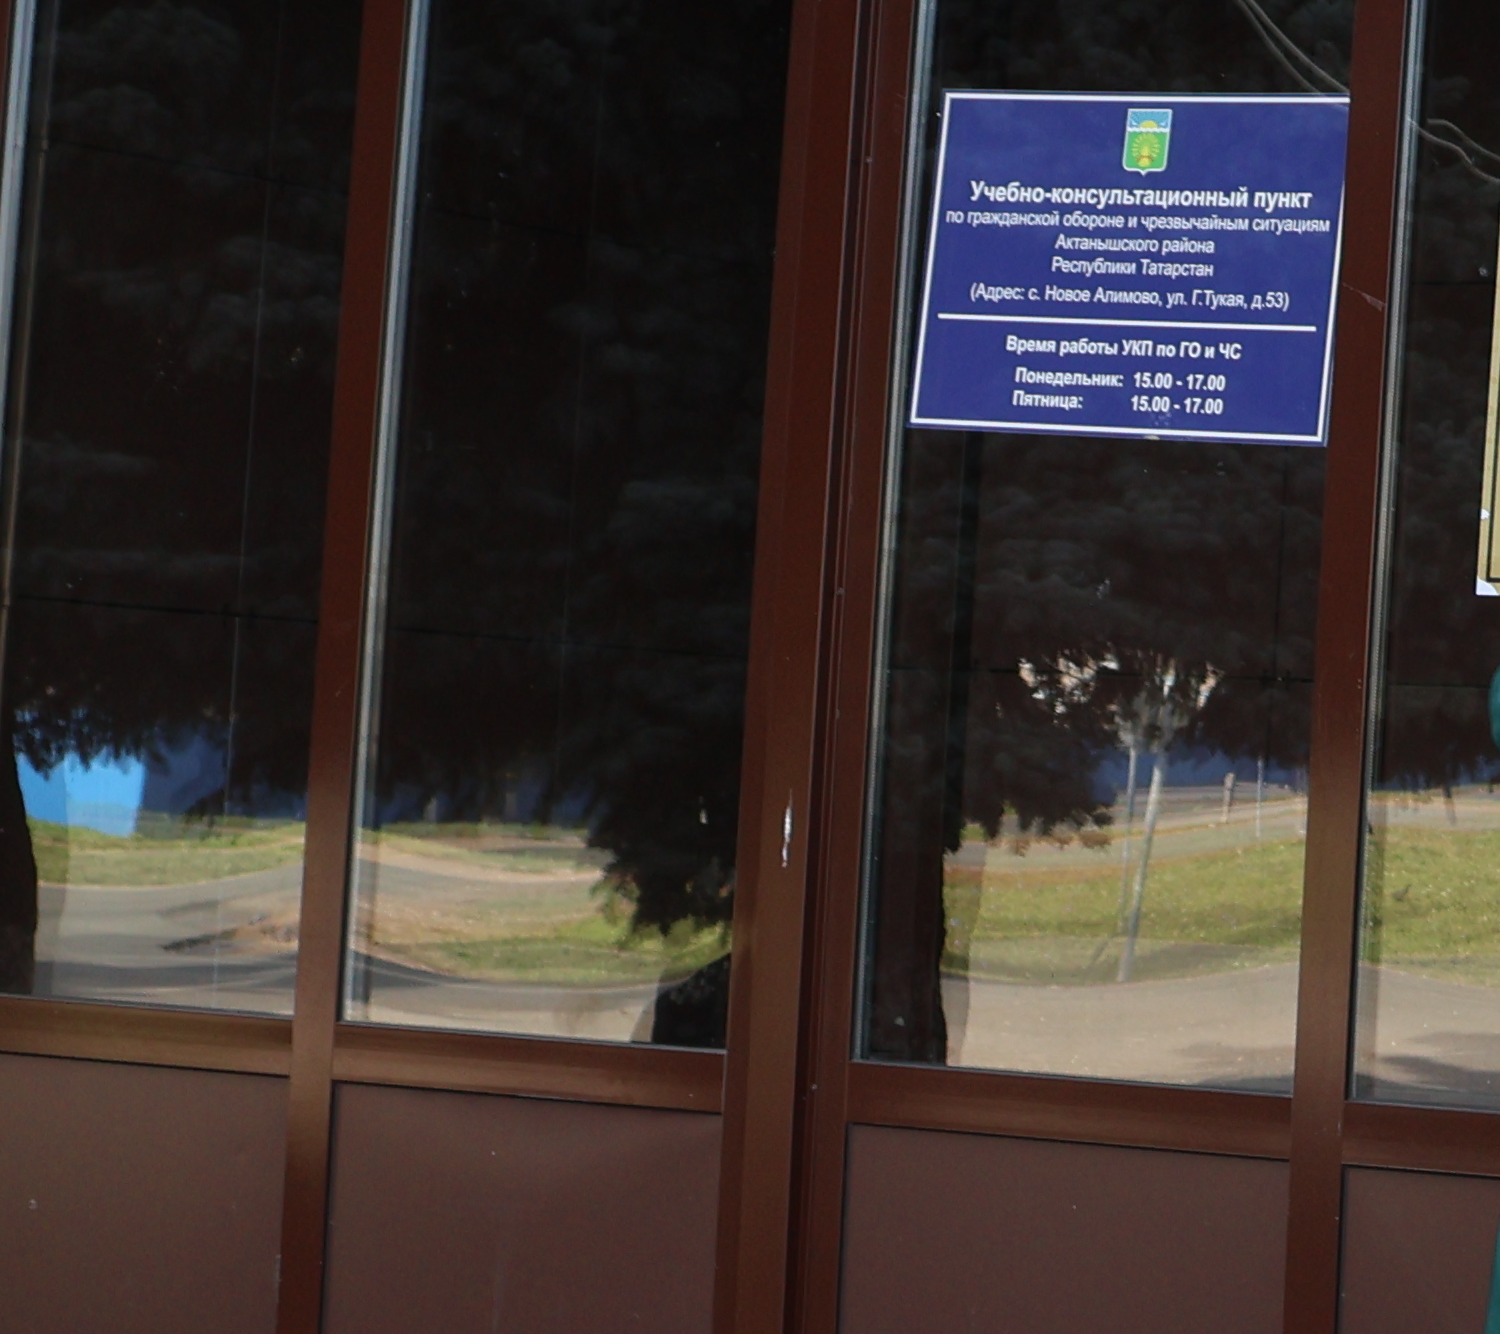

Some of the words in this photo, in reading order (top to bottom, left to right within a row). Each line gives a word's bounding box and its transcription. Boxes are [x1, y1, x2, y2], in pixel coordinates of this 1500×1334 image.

[969, 180, 1248, 209] Учебно-консультационный
[1253, 191, 1313, 213] пункт
[946, 211, 964, 223] по
[967, 210, 1060, 227] гражданской
[1063, 211, 1124, 230] обороне
[1128, 216, 1138, 228] и
[1141, 214, 1248, 232] чрезвычайным
[1252, 218, 1330, 235] ситуациям
[1055, 233, 1159, 251] Актанышского
[1162, 237, 1215, 255] района
[1051, 256, 1136, 277] Республики
[1140, 259, 1214, 279] Татарстан
[970, 282, 1026, 302] (Адрес:
[1028, 289, 1040, 300] с.
[1044, 285, 1091, 302] Новое
[1093, 287, 1162, 306] Алимово,
[1166, 292, 1187, 309] ул.
[1250, 292, 1290, 312] д.53)
[1005, 335, 1056, 355] Время
[1059, 338, 1118, 356] работы
[1121, 339, 1153, 357] УКП
[1156, 344, 1176, 357] по
[1180, 341, 1201, 358] ГО
[1204, 346, 1215, 359] и
[1219, 343, 1242, 360] ЧС
[1014, 366, 1124, 387] Понедельник:
[1133, 372, 1173, 390] 15.00
[1186, 374, 1226, 391] 17.00
[1012, 390, 1083, 411] Пятница:
[1131, 395, 1170, 413] 15.00
[1183, 397, 1223, 414] 17.00
